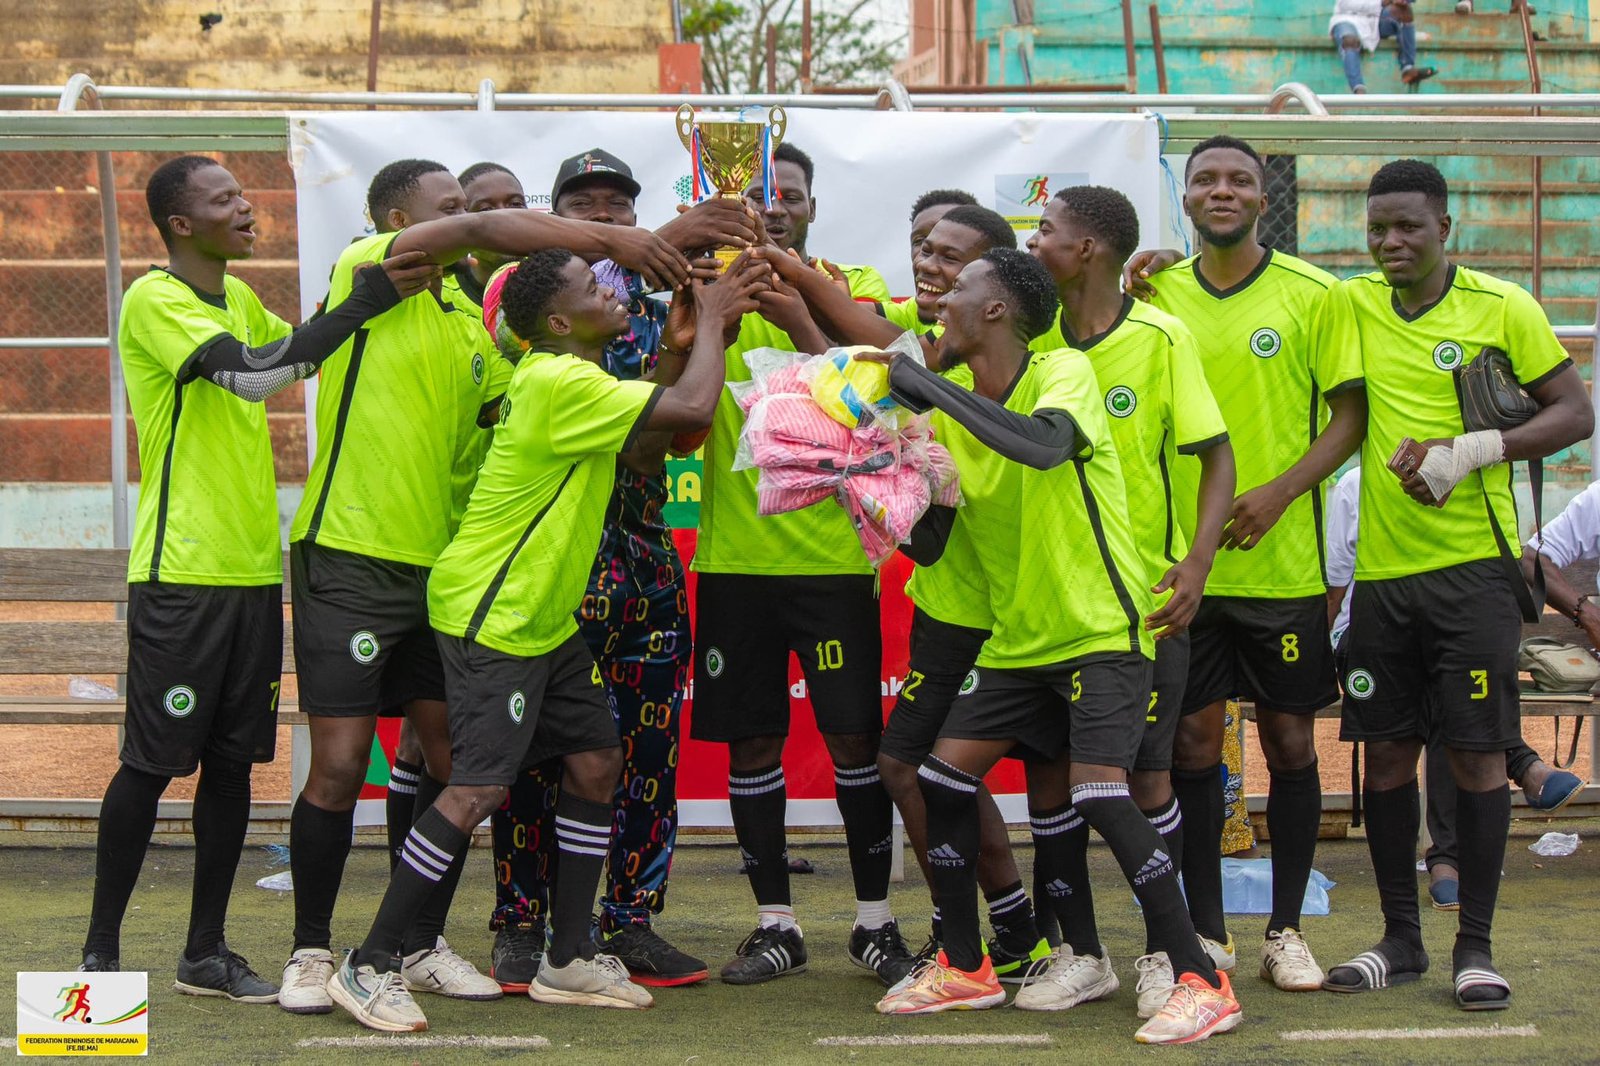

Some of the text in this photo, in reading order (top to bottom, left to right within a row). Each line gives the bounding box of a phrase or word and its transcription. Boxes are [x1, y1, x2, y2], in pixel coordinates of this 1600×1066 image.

[816, 640, 844, 670] 10
[1281, 633, 1299, 662] 8
[591, 660, 604, 688] 4
[1071, 671, 1082, 702] 5
[1470, 670, 1488, 699] 3
[270, 681, 280, 711] 7
